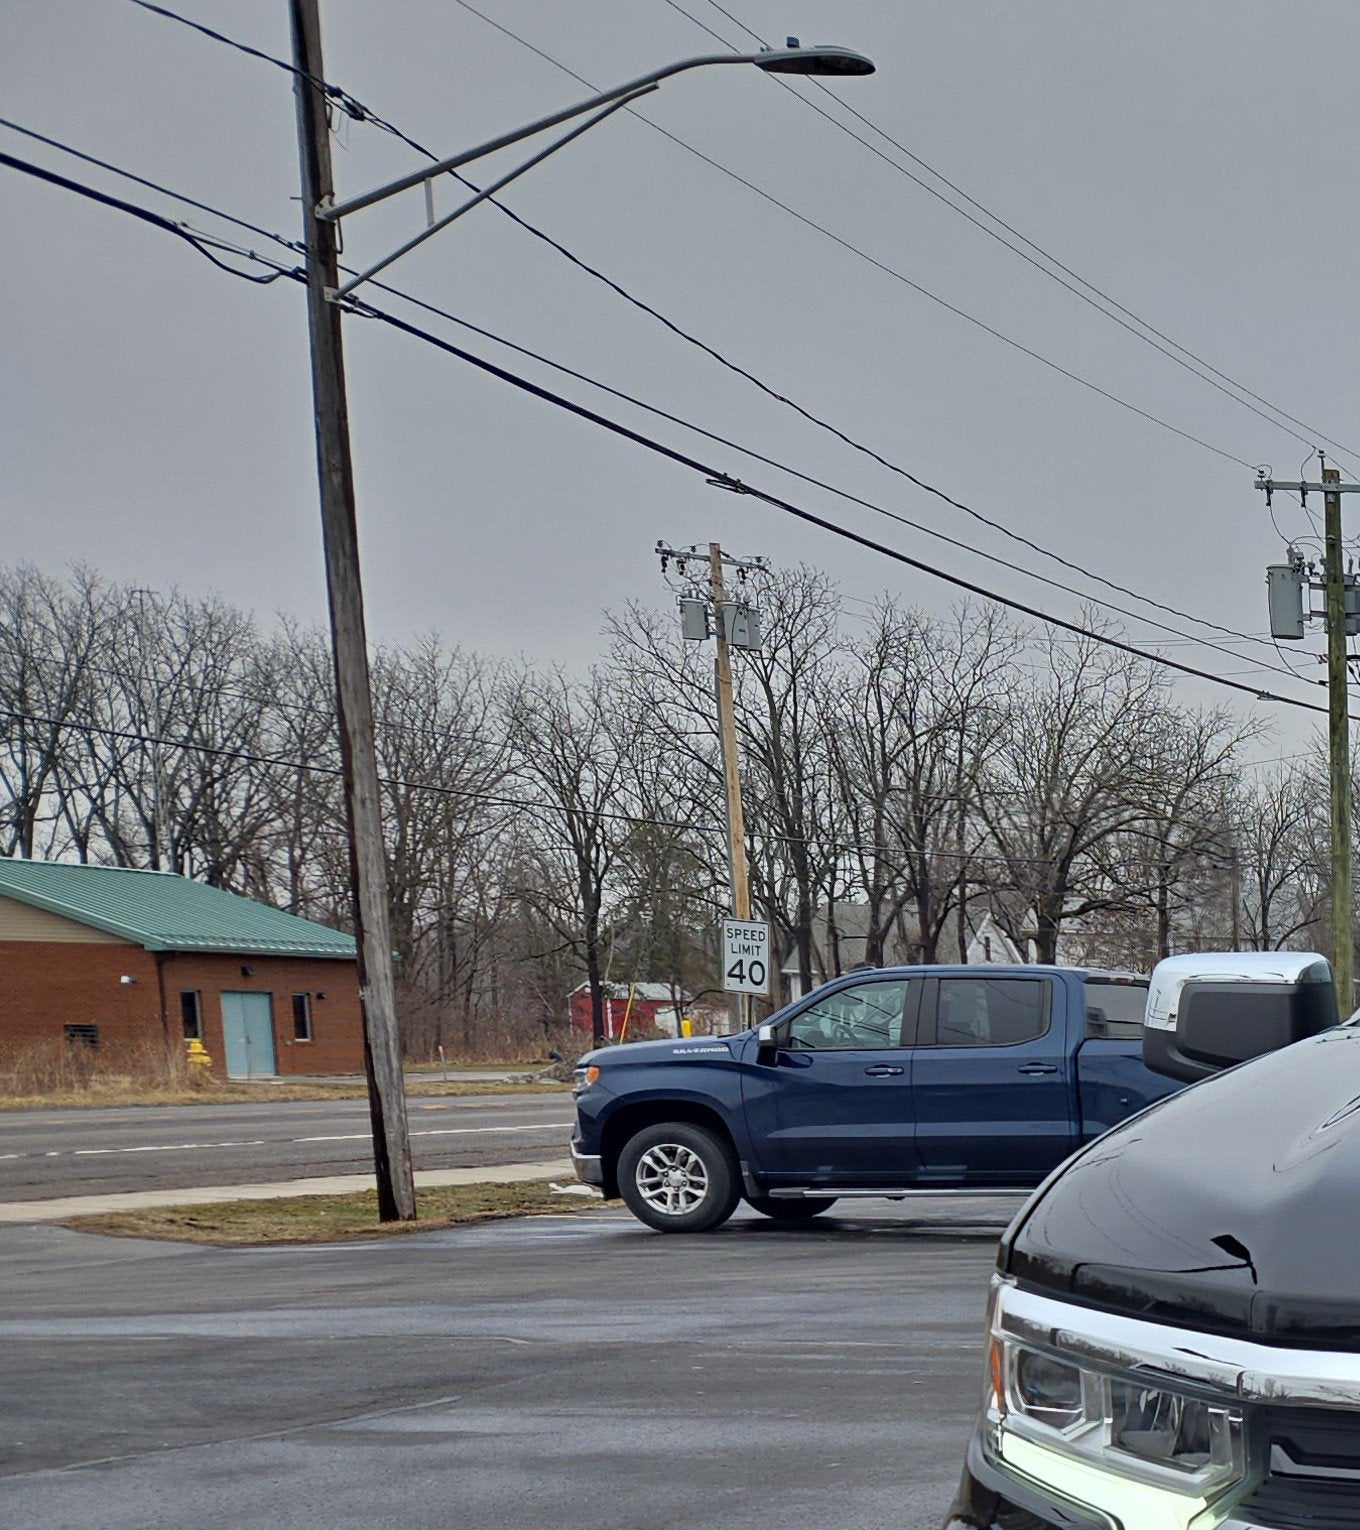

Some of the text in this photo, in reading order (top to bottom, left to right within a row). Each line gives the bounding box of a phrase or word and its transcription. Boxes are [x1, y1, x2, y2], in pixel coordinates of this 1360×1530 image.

[726, 927, 766, 942] SPEED
[730, 943, 762, 956] LIMIT
[727, 958, 766, 987] 40
